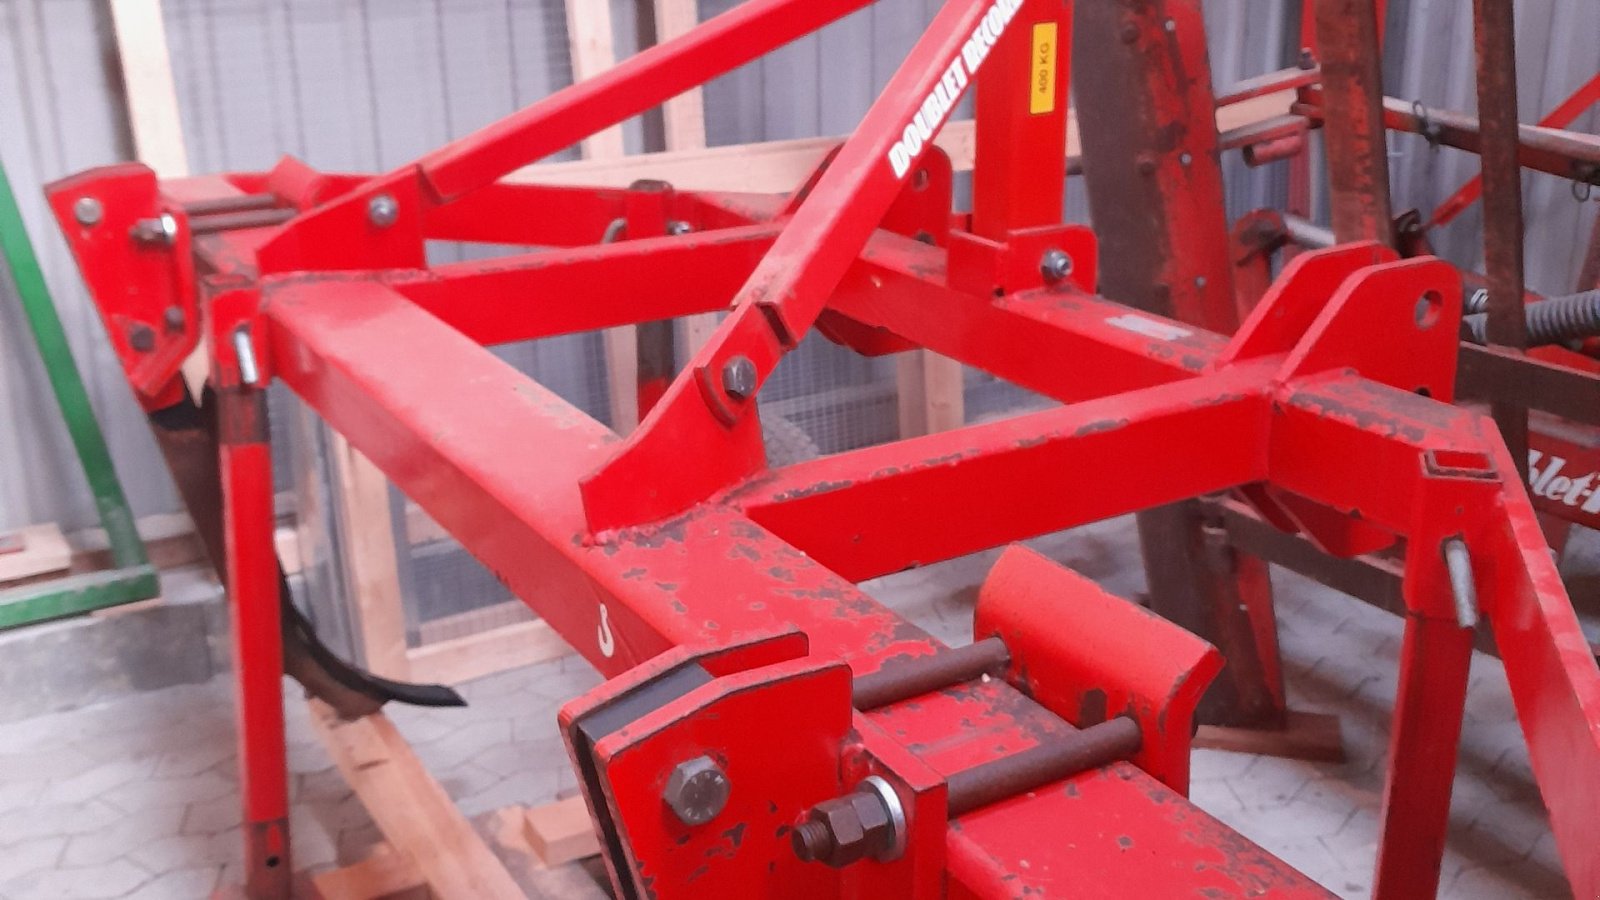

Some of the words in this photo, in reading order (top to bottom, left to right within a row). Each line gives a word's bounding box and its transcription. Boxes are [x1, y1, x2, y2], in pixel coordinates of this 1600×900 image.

[1039, 42, 1050, 65] KG
[1038, 69, 1049, 94] 400
[888, 55, 969, 180] DOUBLET
